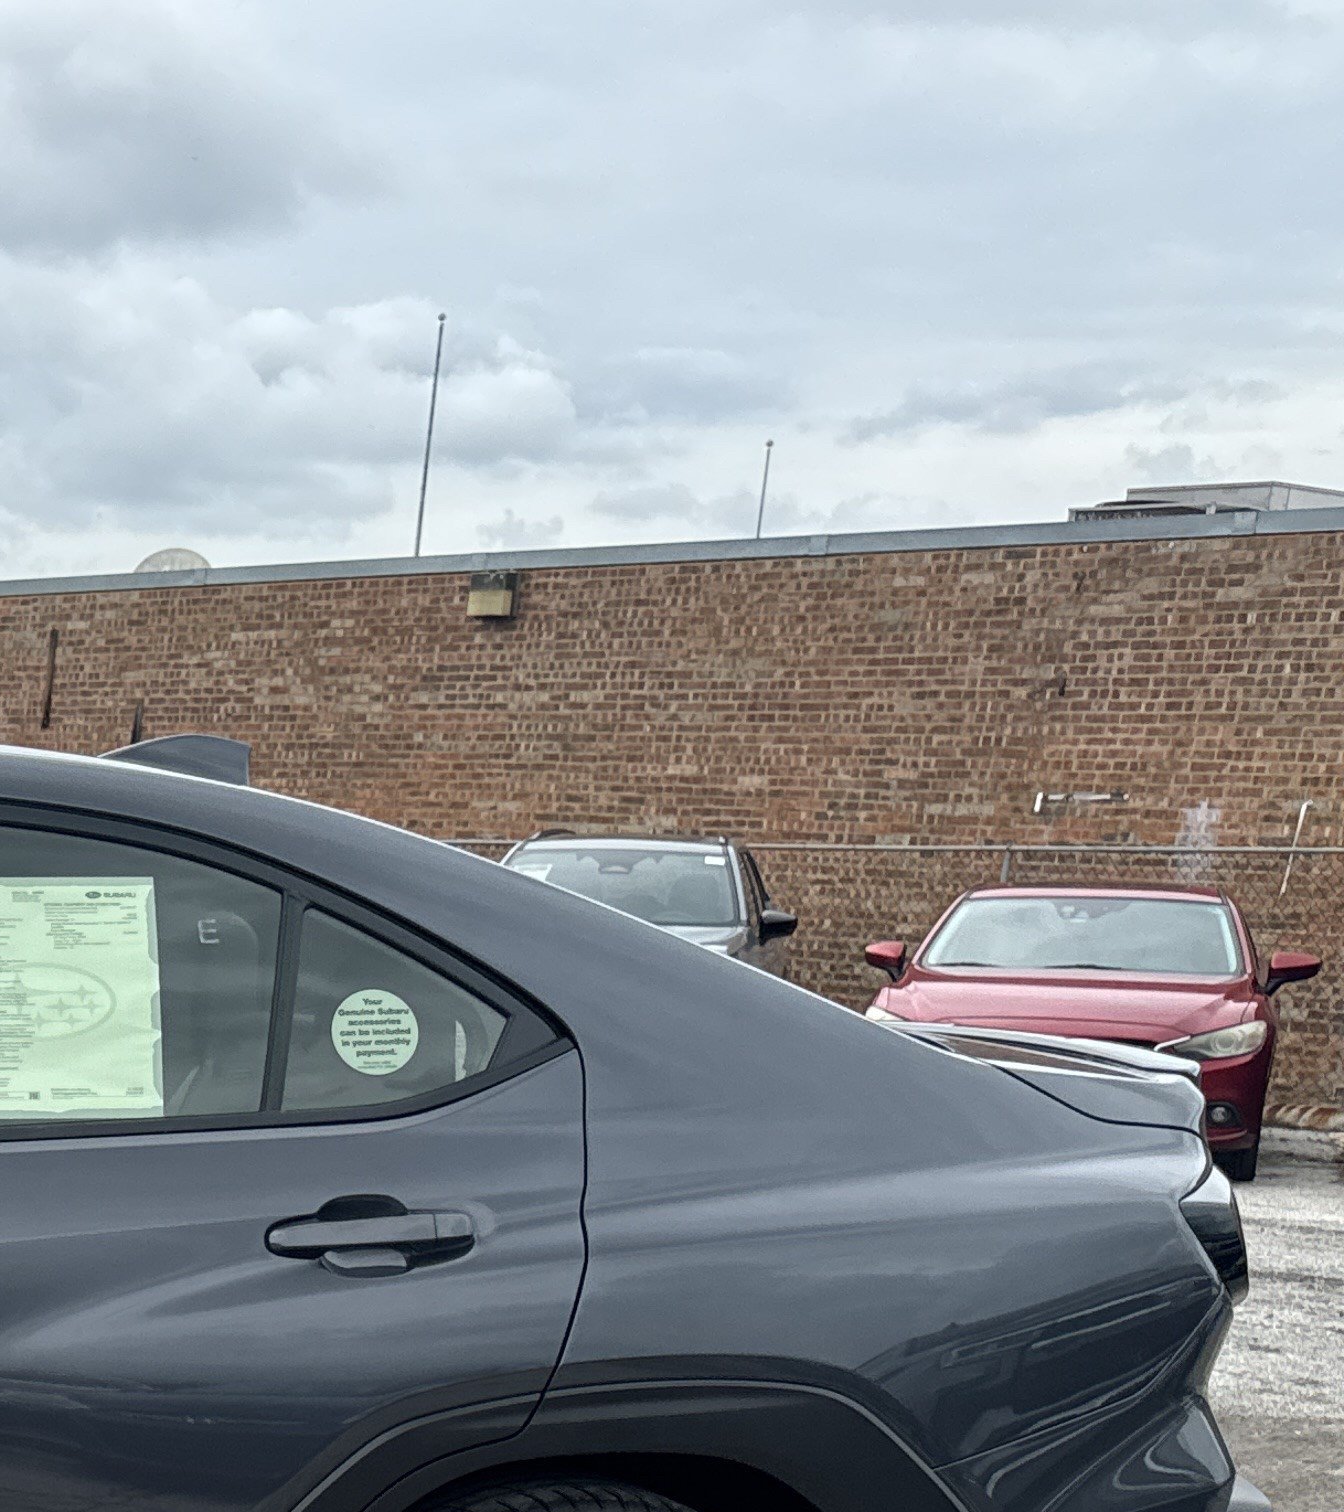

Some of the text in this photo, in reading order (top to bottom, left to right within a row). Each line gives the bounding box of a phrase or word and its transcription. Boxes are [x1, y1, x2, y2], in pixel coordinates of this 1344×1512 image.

[198, 919, 219, 944] E
[362, 998, 383, 1006] Your
[337, 1007, 409, 1017] Genuine Subaru
[348, 1018, 401, 1026] accessories
[374, 1038, 411, 1046] monthly
